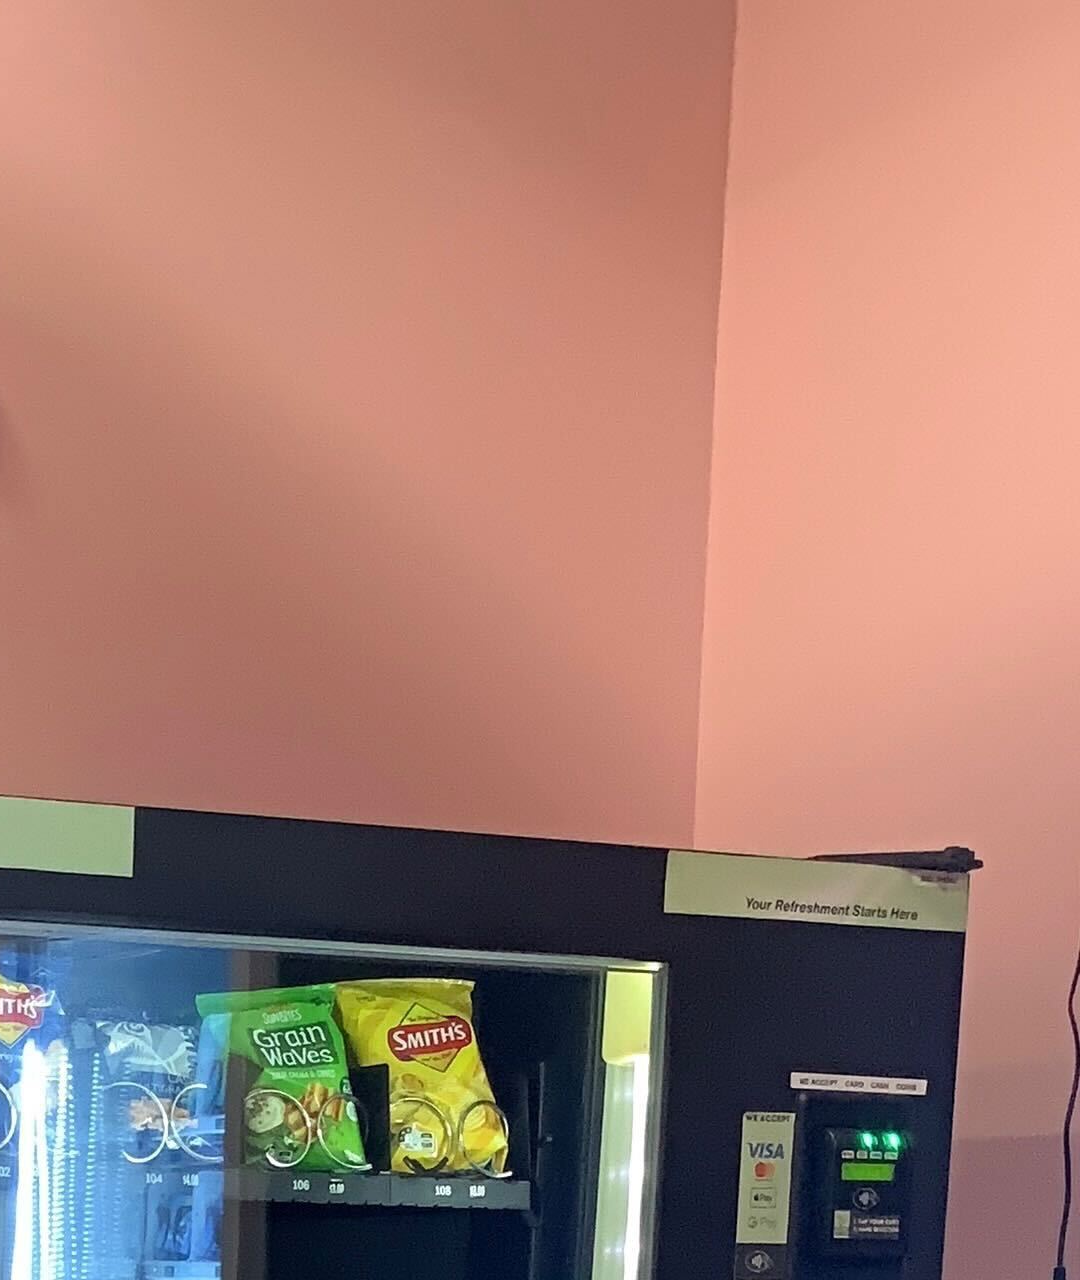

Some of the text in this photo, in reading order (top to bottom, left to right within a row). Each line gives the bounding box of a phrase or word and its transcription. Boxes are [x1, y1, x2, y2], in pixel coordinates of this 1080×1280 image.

[746, 897, 918, 921] Your Refreshment Starts Here
[253, 1025, 326, 1048] Grain
[392, 1022, 467, 1051] SMITH'S
[748, 1143, 784, 1159] VISA
[146, 1173, 163, 1184] 104
[293, 1179, 310, 1190] 106
